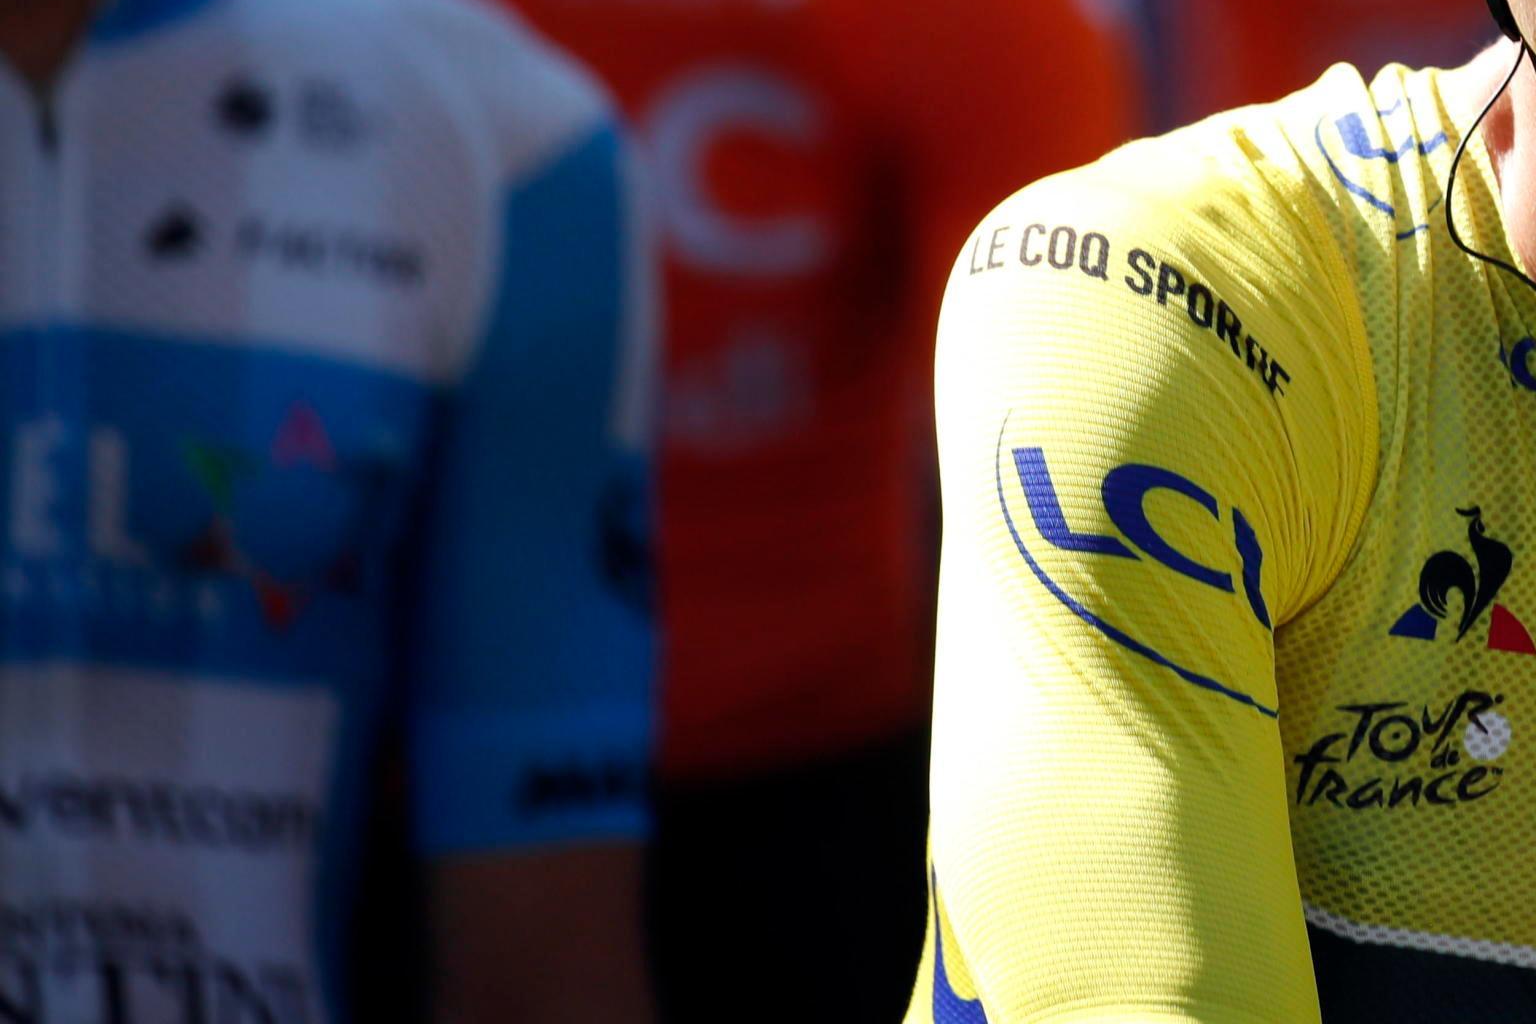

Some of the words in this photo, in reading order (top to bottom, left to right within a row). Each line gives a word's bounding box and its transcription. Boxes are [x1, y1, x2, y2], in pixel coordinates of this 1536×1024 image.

[969, 226, 1010, 276] LE
[1018, 223, 1110, 282] COQ
[1430, 741, 1461, 769] de
